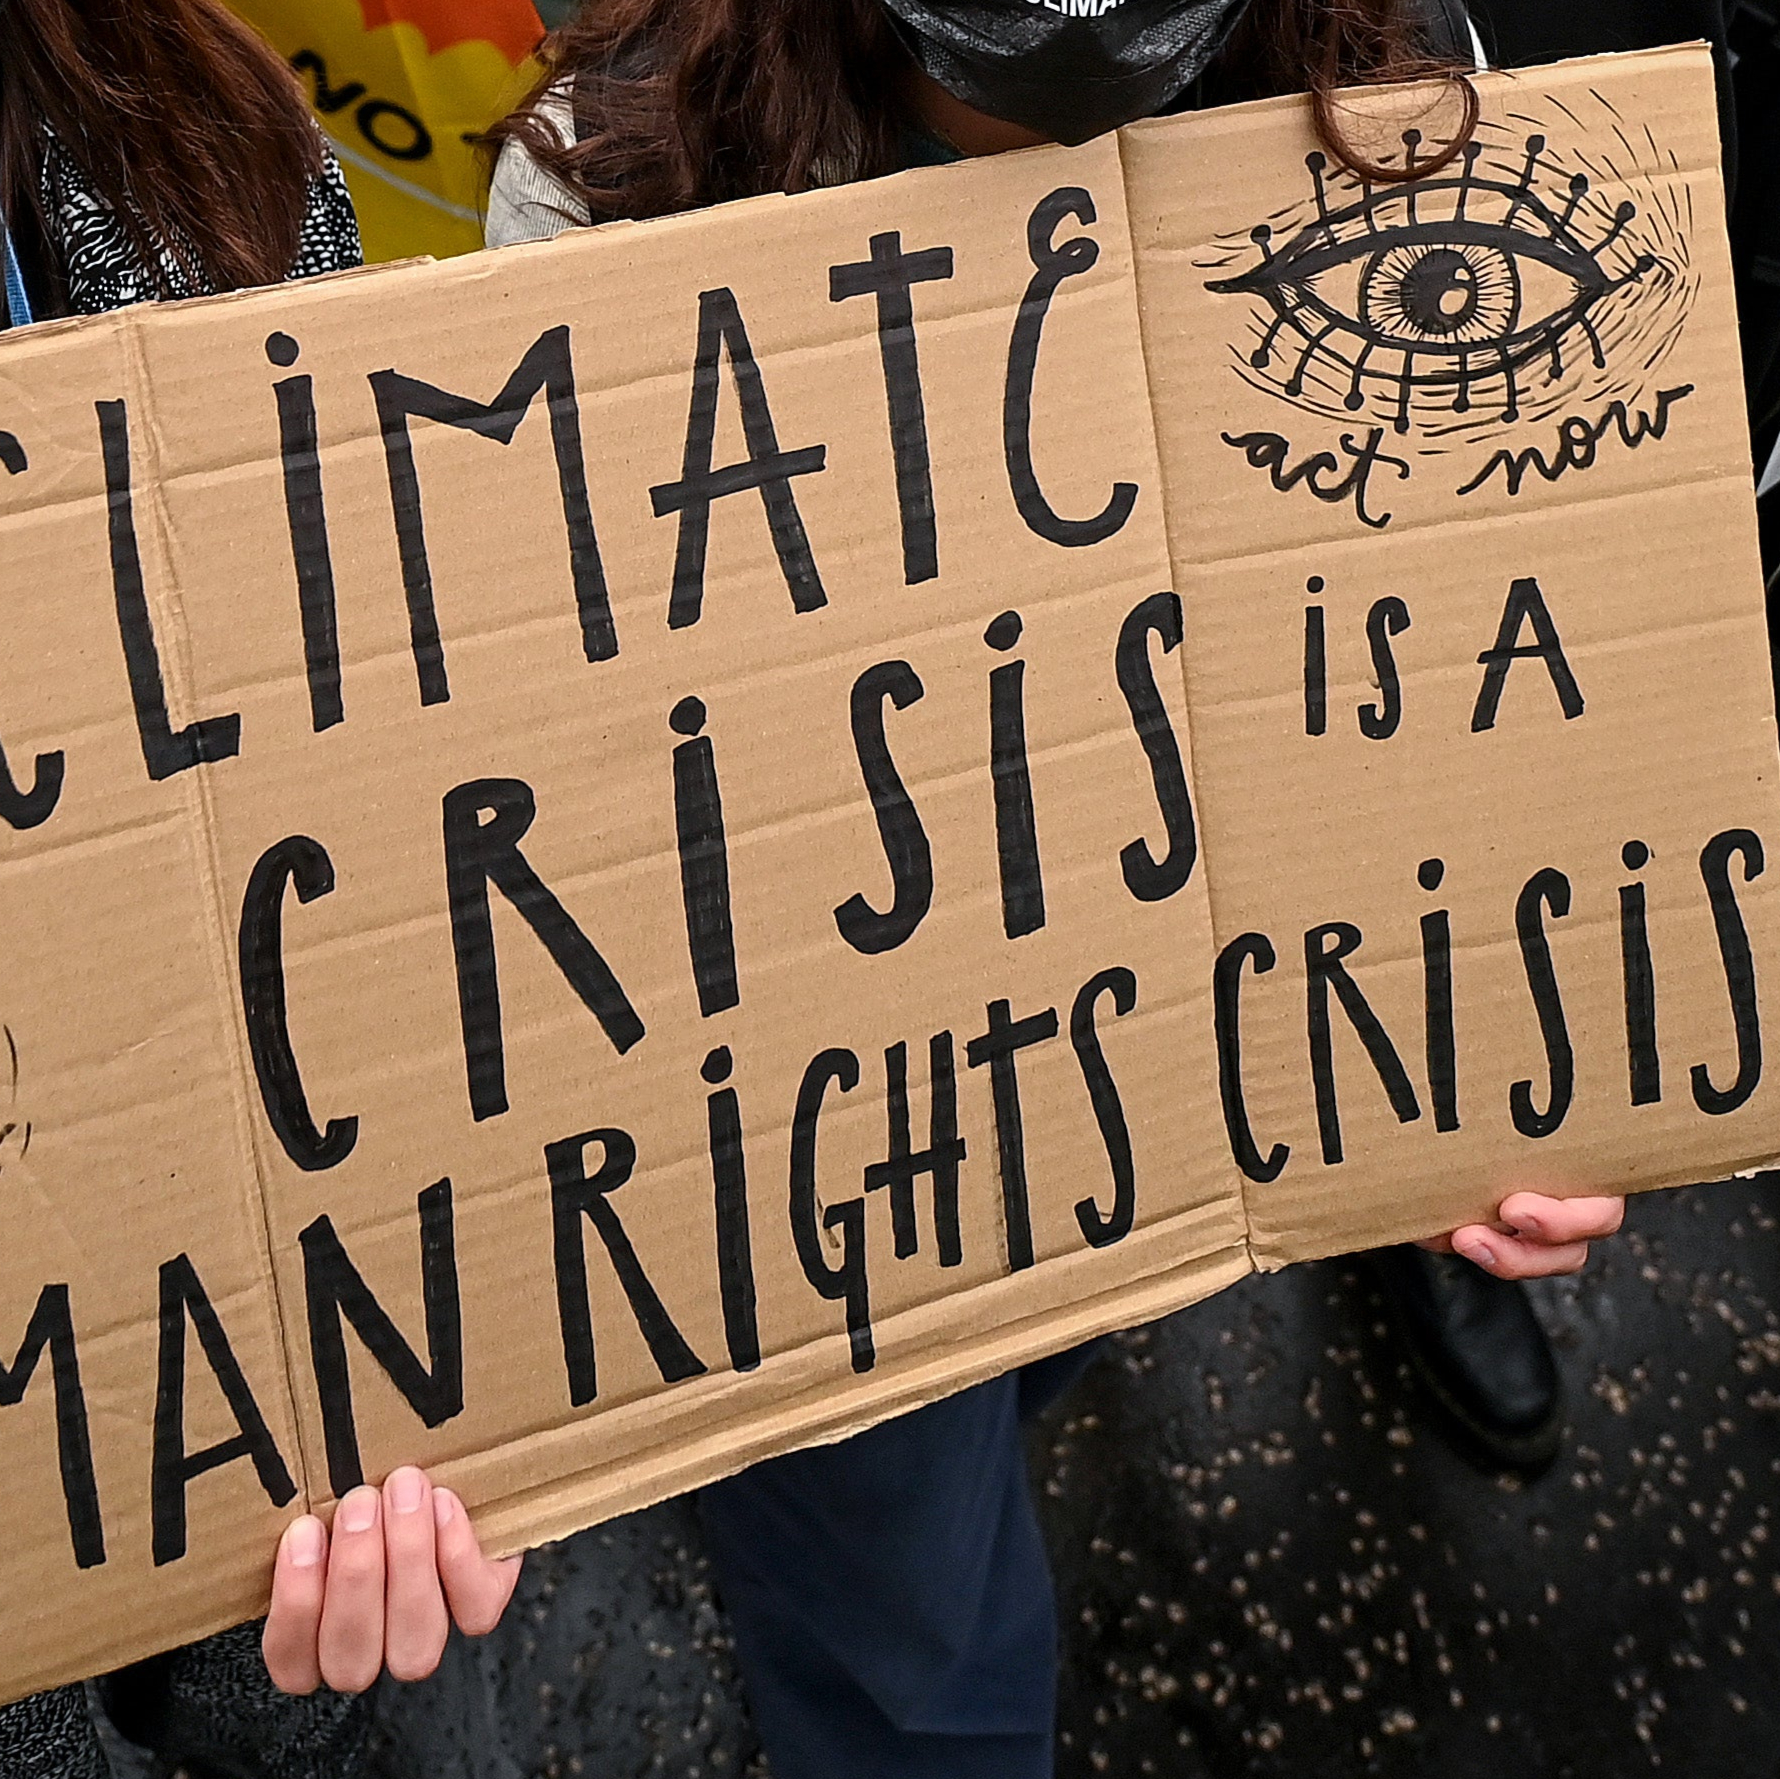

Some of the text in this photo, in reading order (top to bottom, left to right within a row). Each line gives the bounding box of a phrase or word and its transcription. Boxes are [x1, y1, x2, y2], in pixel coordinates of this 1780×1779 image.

[288, 48, 435, 163] NO
[1220, 383, 1696, 528] act now
[237, 591, 1198, 1171] CRISIS
[1470, 577, 1585, 733] A
[543, 965, 1138, 1405] RIGHTS
[1213, 828, 1766, 1184] CRISIS
